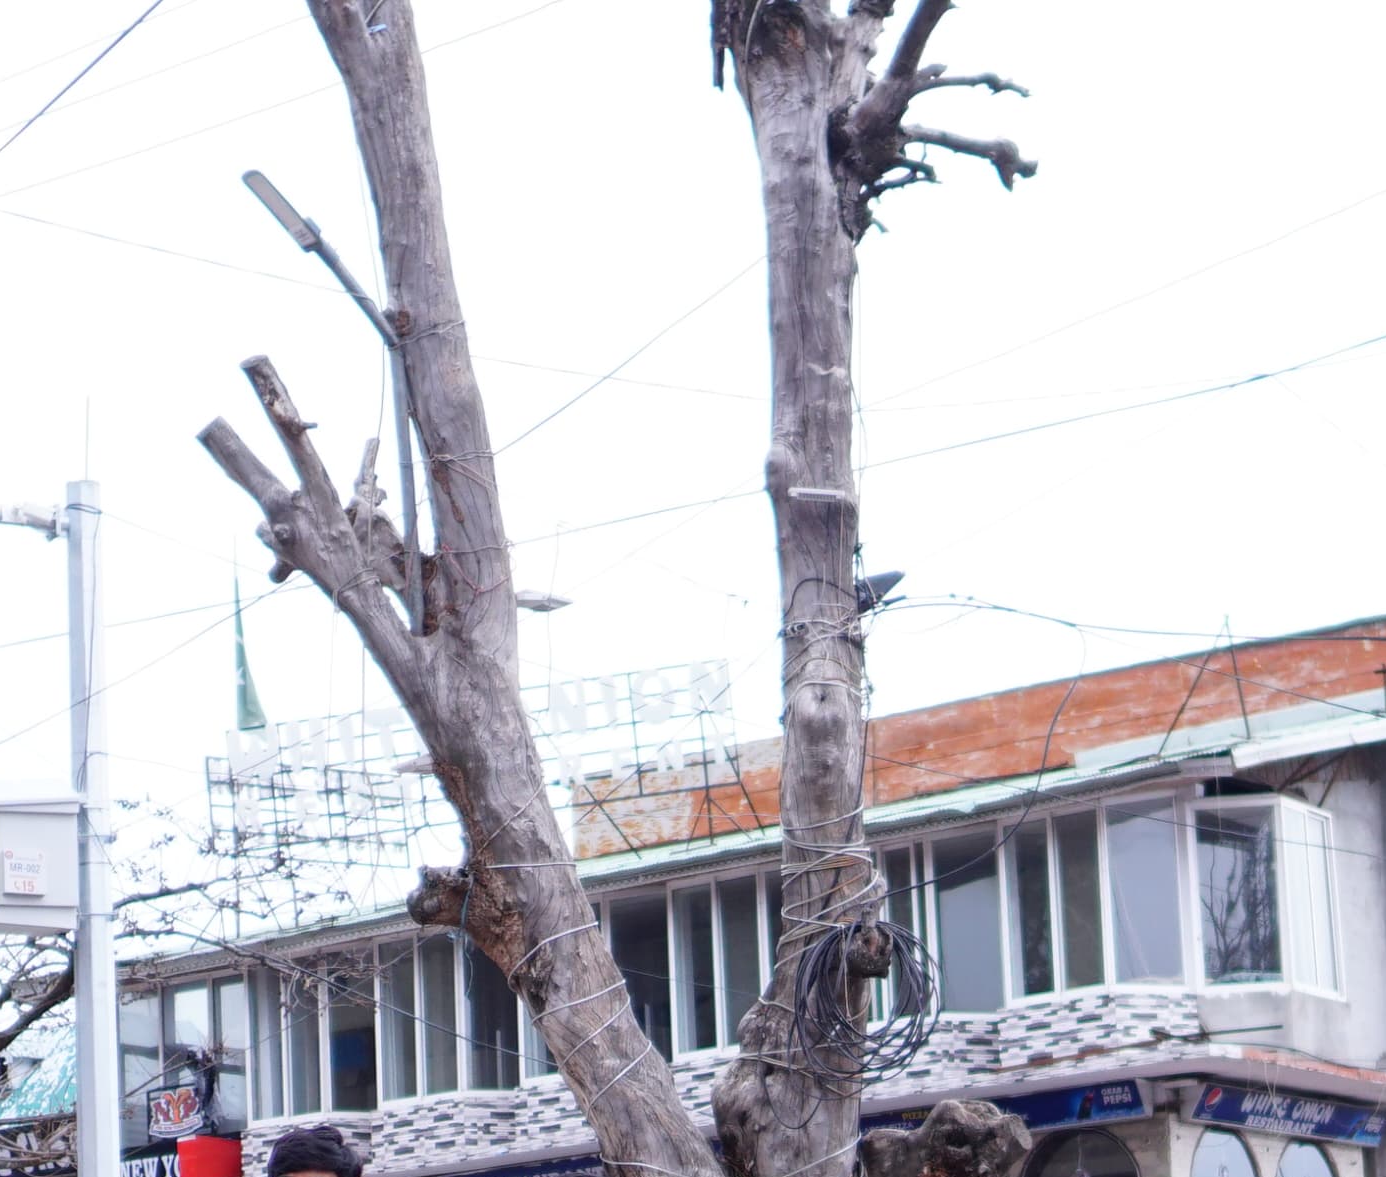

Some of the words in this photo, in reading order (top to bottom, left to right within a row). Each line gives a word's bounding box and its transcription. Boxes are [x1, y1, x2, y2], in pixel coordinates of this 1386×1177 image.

[9, 863, 42, 874] MR-002
[23, 880, 35, 892] 15
[153, 1089, 198, 1124] NYP
[1103, 1093, 1132, 1105] PEPSI
[1241, 1093, 1291, 1119] WHITE
[1292, 1100, 1335, 1124] ONION
[1245, 1114, 1316, 1135] RESTAURANT
